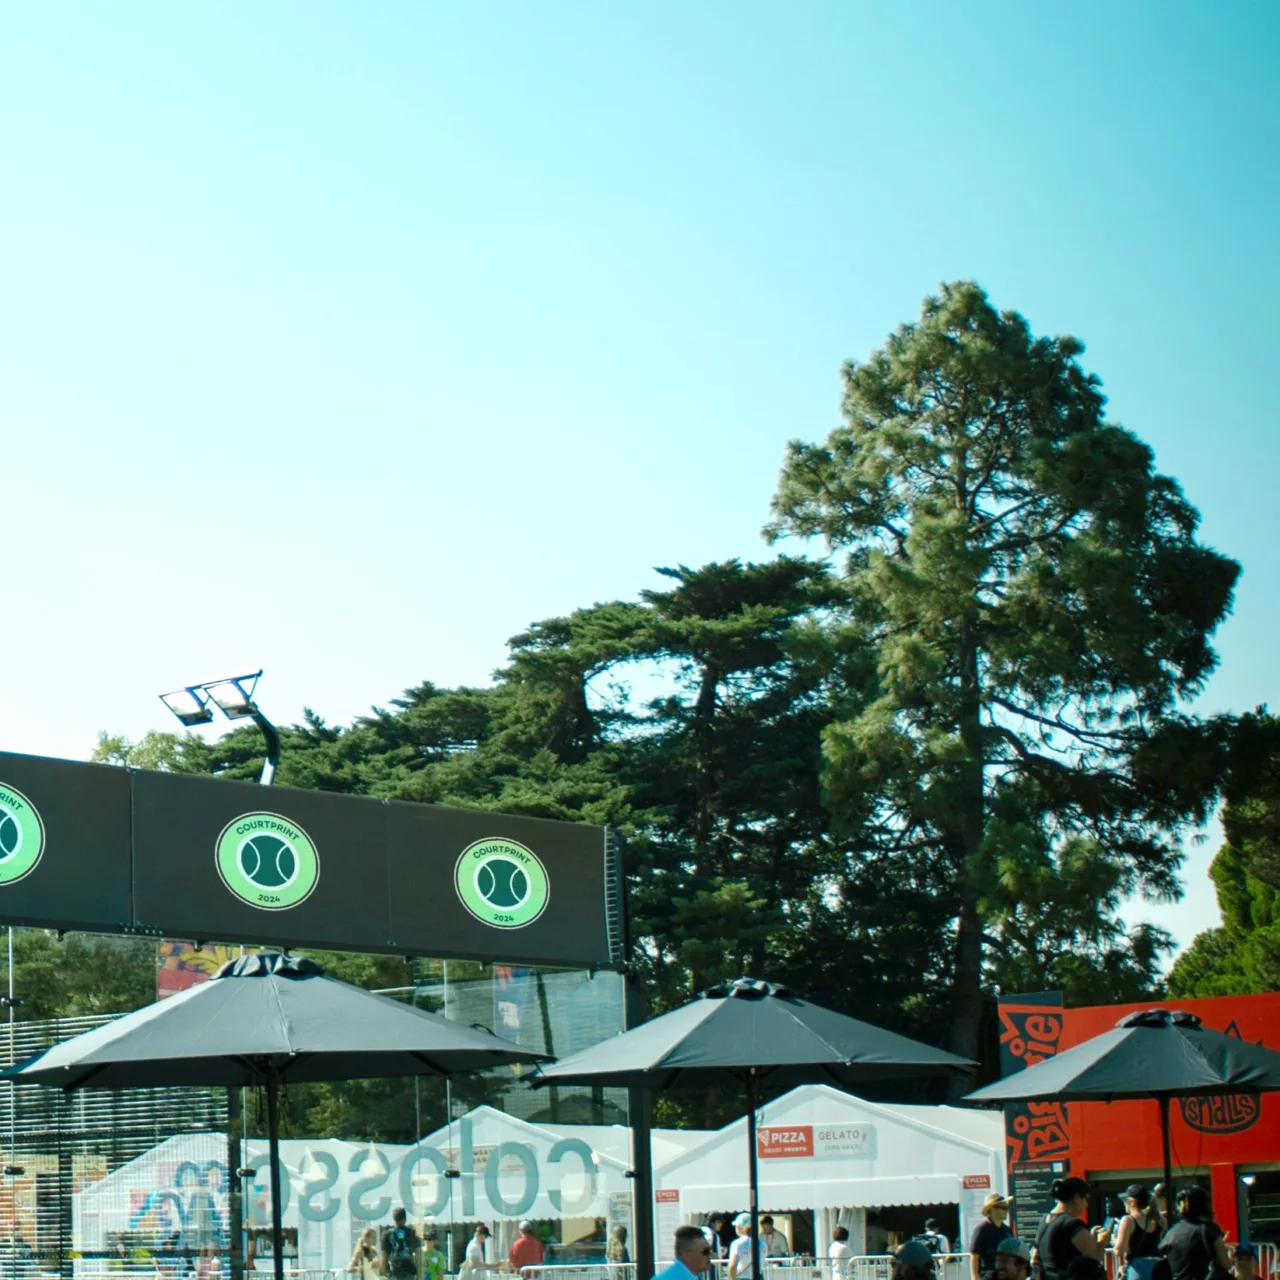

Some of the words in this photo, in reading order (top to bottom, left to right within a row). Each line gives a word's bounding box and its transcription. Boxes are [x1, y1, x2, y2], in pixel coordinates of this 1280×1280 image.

[236, 820, 300, 841] COURTPRINT
[473, 845, 531, 864] COURTPRINT
[258, 894, 280, 903] 2024
[493, 913, 514, 922] 2024
[771, 1132, 806, 1144] PIZZA
[818, 1130, 860, 1141] GELATO
